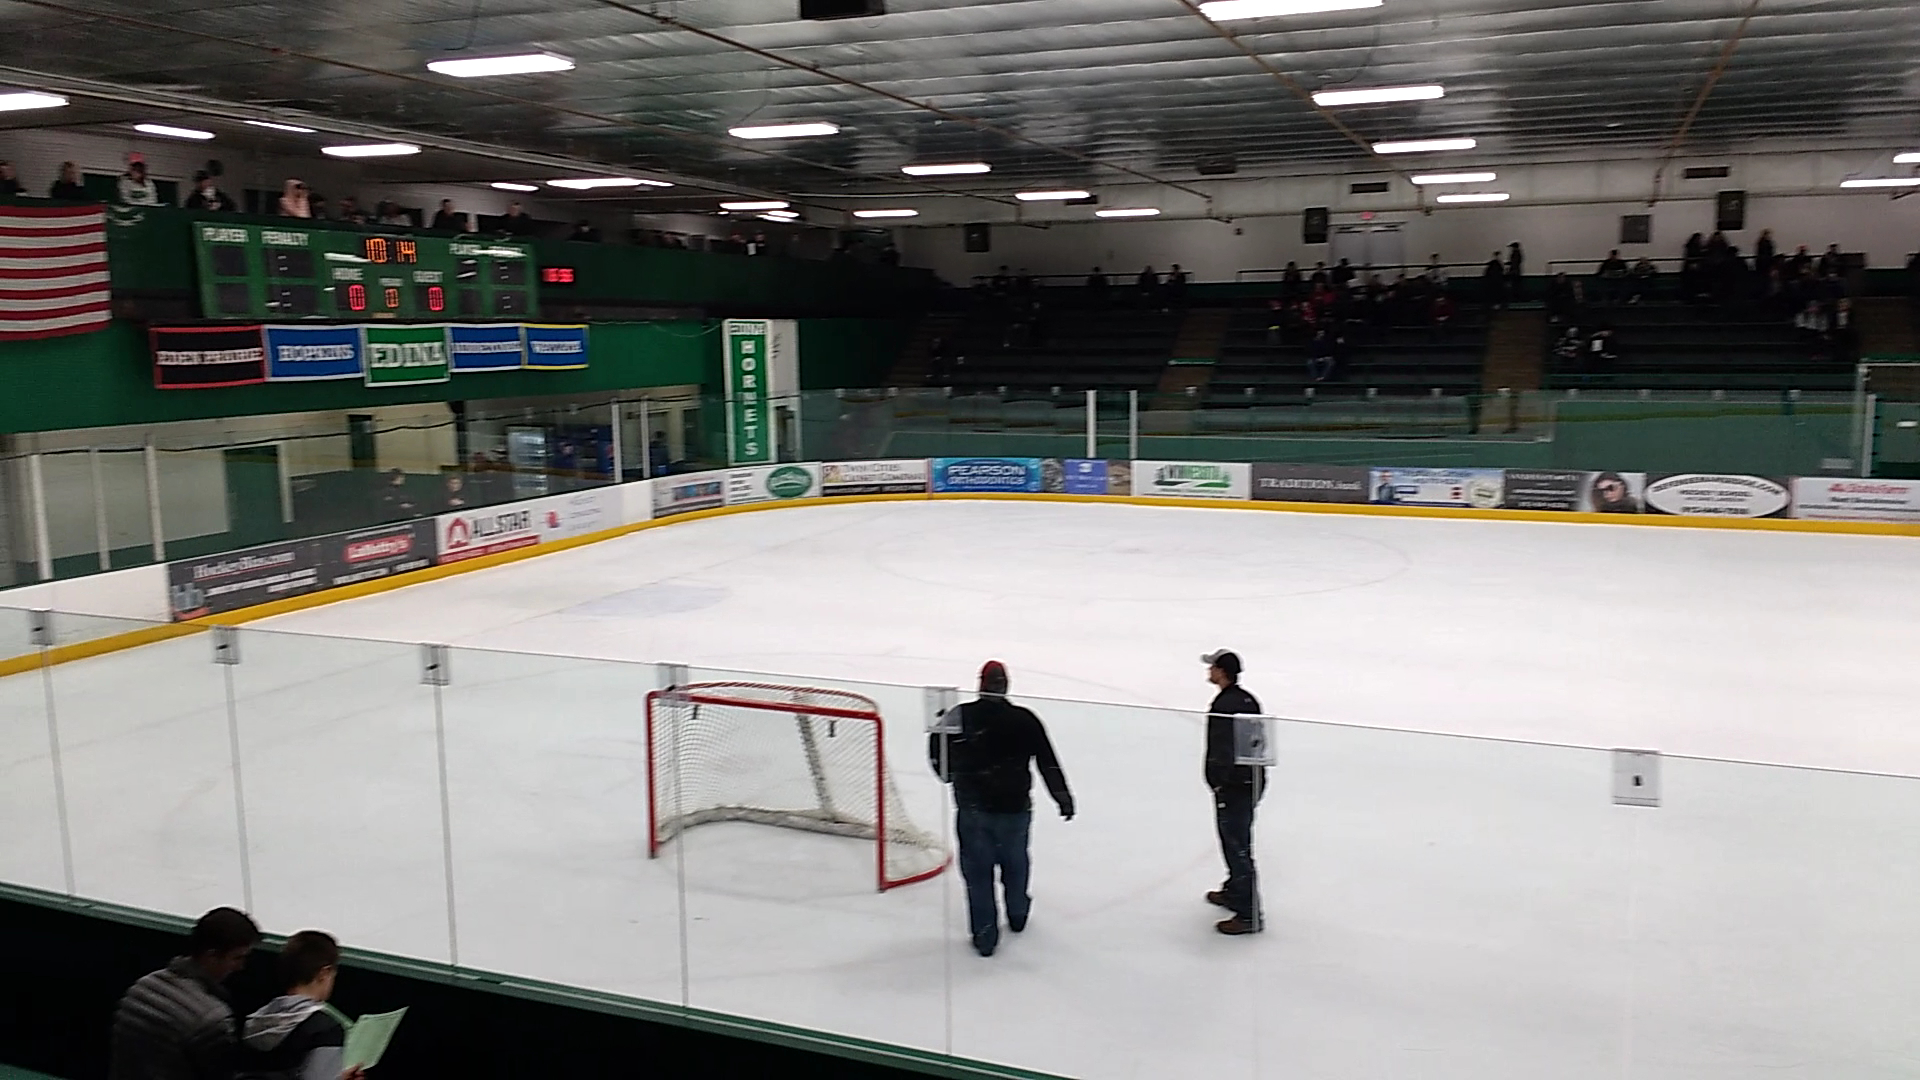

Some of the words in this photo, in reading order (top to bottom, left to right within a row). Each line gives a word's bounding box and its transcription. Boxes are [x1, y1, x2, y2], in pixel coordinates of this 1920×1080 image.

[348, 284, 365, 310] 0
[428, 286, 444, 311] 0
[368, 341, 447, 368] EDINA
[740, 340, 759, 456] HORNETS
[947, 476, 1026, 485] ORTHODONTICS
[948, 465, 1026, 476] PEARSON
